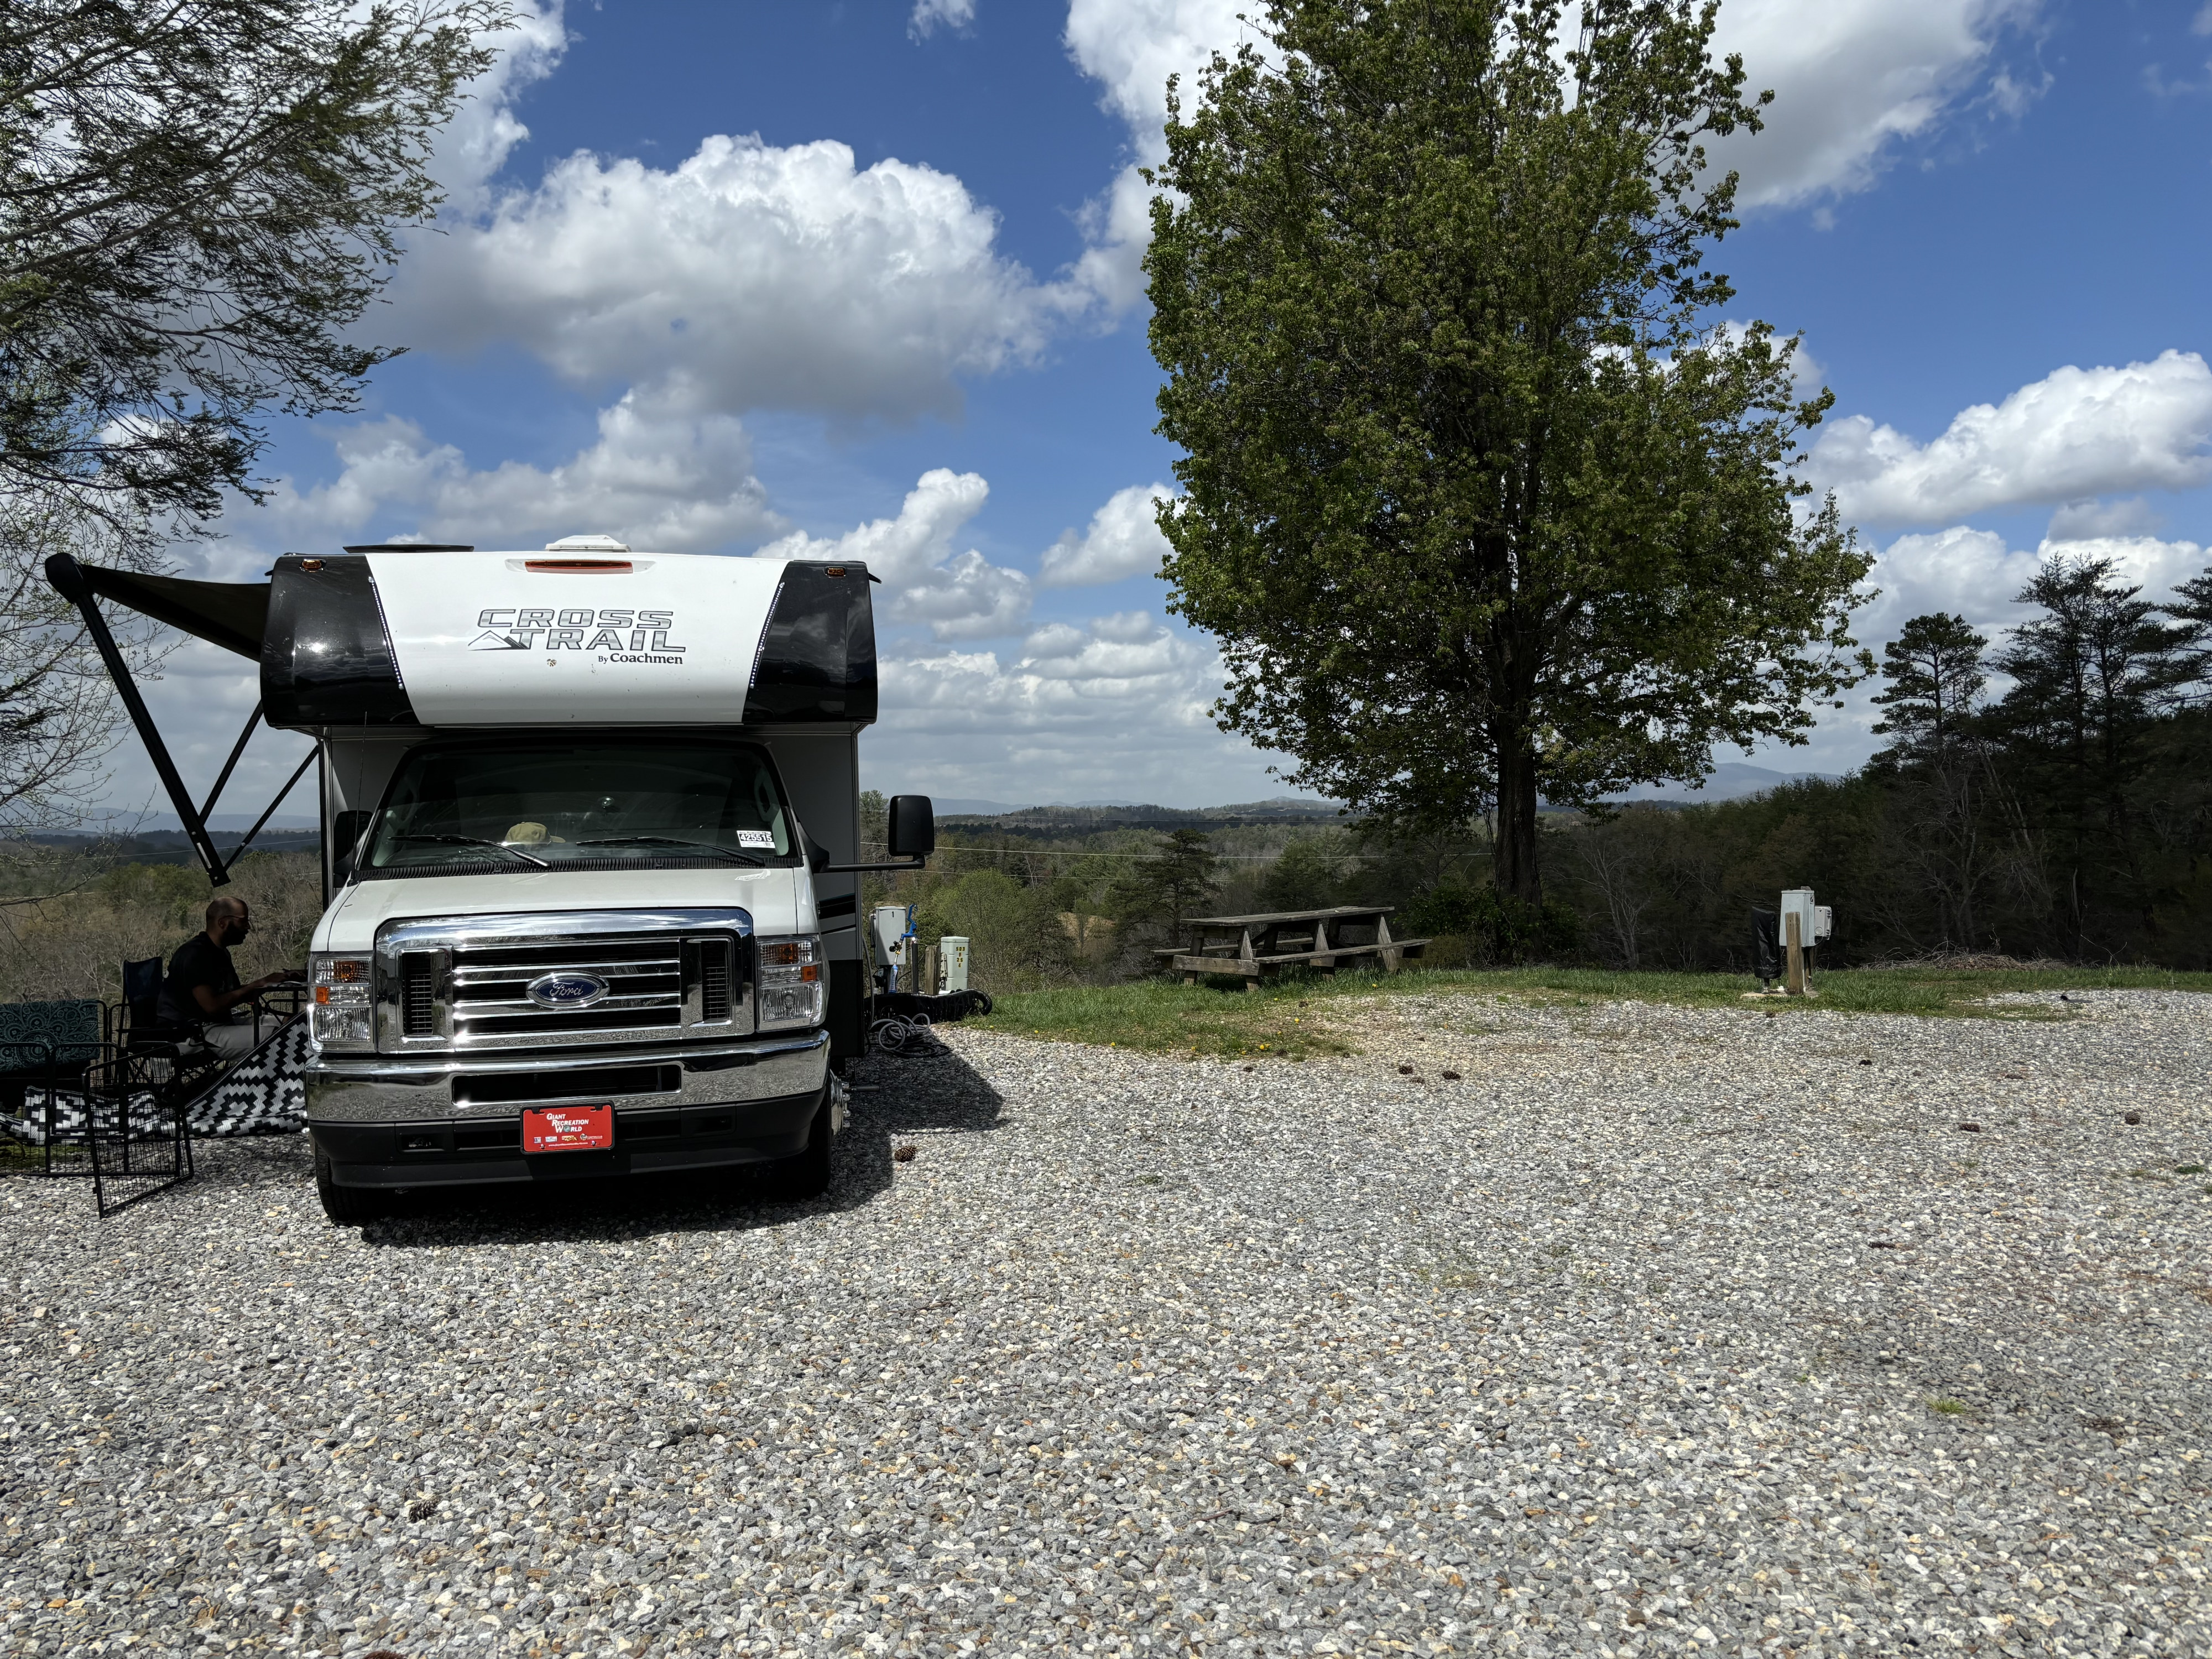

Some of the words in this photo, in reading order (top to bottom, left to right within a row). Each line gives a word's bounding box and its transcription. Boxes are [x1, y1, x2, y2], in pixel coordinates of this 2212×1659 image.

[478, 609, 673, 629] CROSS
[510, 629, 686, 652] TRAIL
[610, 653, 683, 664] Coachmen
[549, 982, 583, 997] Ford
